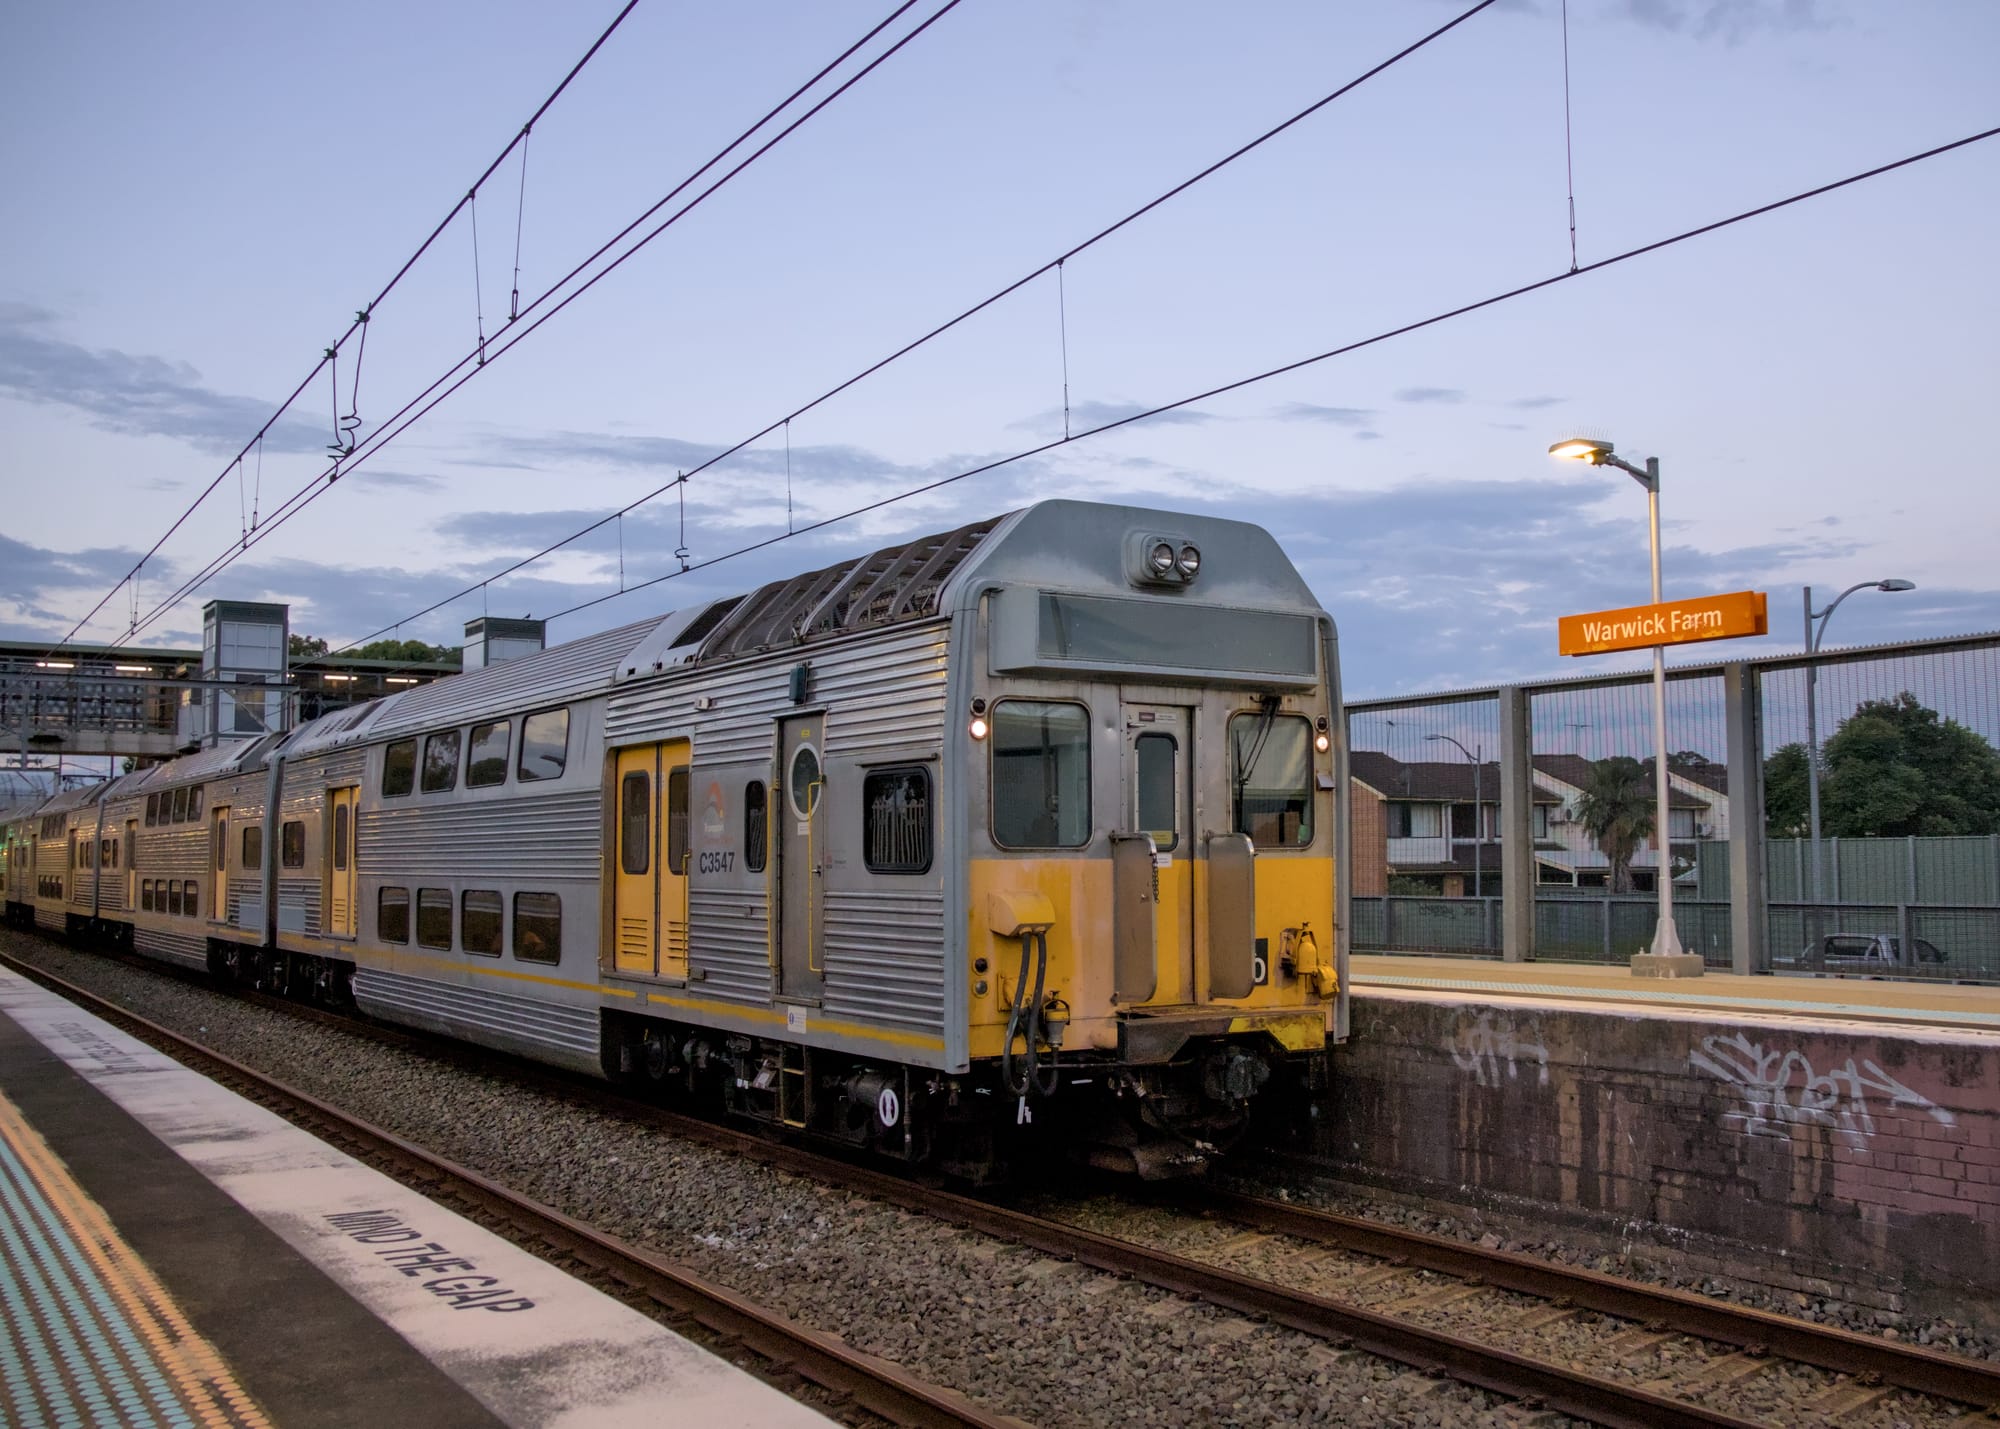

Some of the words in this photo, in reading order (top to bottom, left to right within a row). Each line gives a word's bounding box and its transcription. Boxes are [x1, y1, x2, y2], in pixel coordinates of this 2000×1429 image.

[1583, 613, 1665, 643] Warwick
[1671, 609, 1722, 633] Farm
[700, 852, 735, 874] C3547
[322, 1209, 422, 1244] MIND
[374, 1242, 477, 1277] THE
[422, 1275, 536, 1313] GAP
